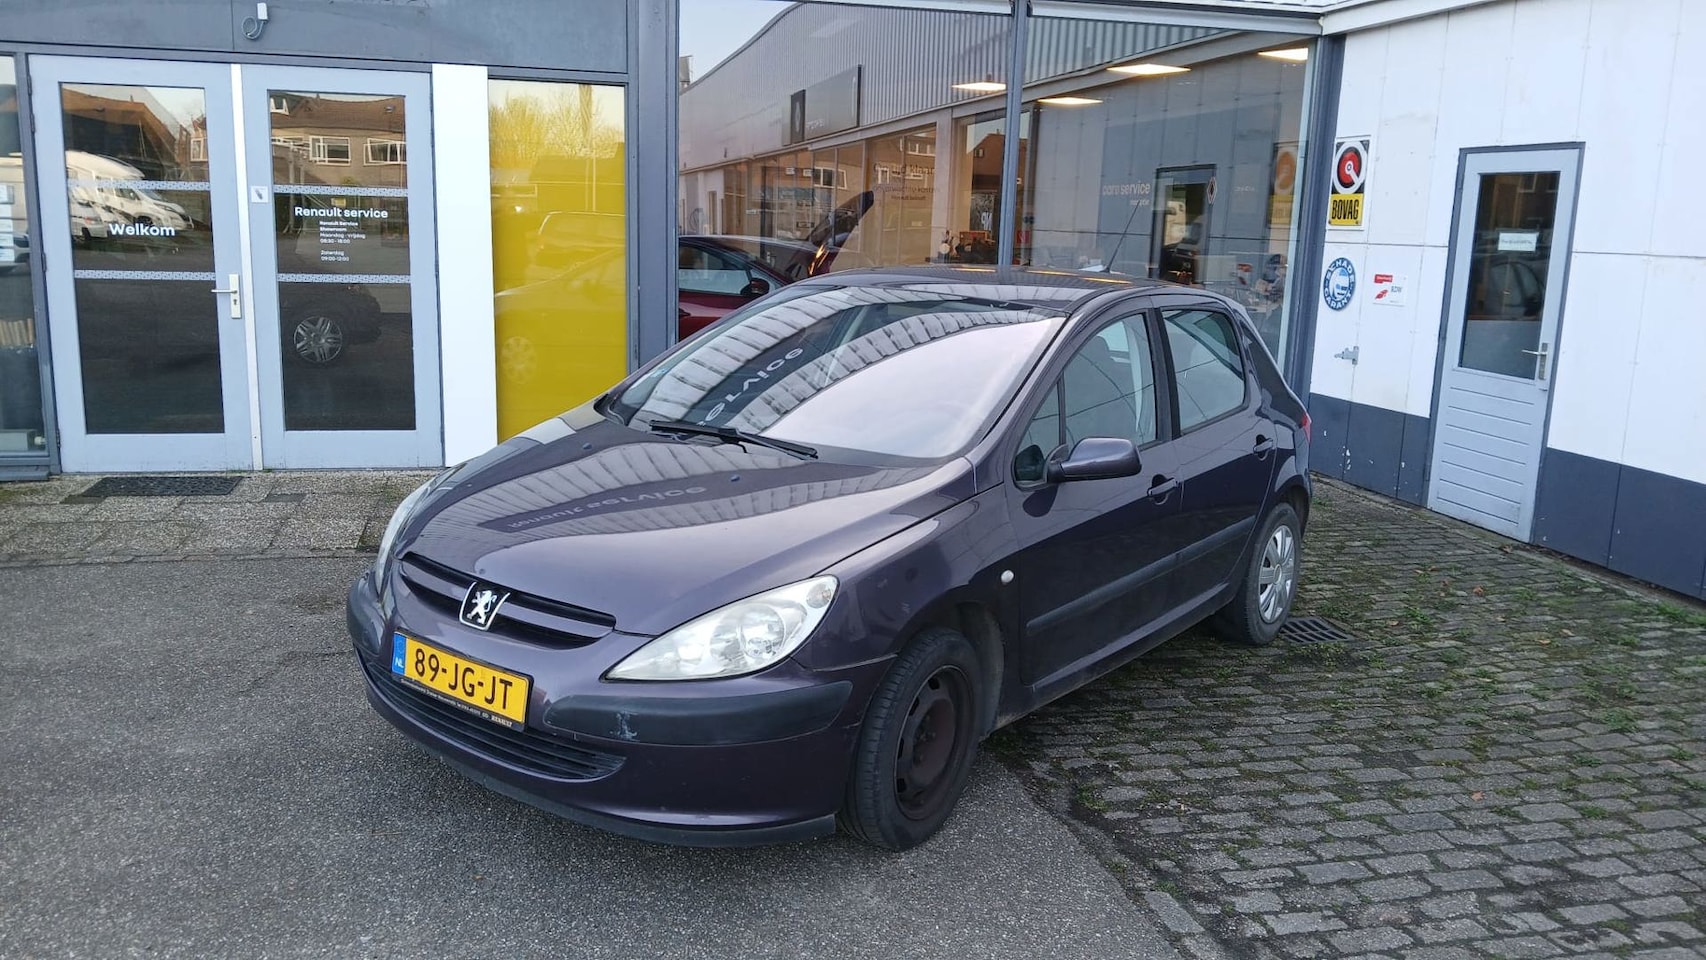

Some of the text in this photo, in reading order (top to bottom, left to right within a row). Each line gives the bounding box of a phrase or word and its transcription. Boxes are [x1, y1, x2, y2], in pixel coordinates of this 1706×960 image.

[1121, 180, 1150, 195] service
[294, 206, 389, 218] Renault service
[1331, 199, 1360, 220] BOVAG
[108, 223, 175, 236] Welkom
[1326, 259, 1355, 283] SCHADE
[1324, 288, 1353, 309] GARANT
[394, 656, 404, 668] NL
[414, 648, 513, 710] 89-JG-JT
